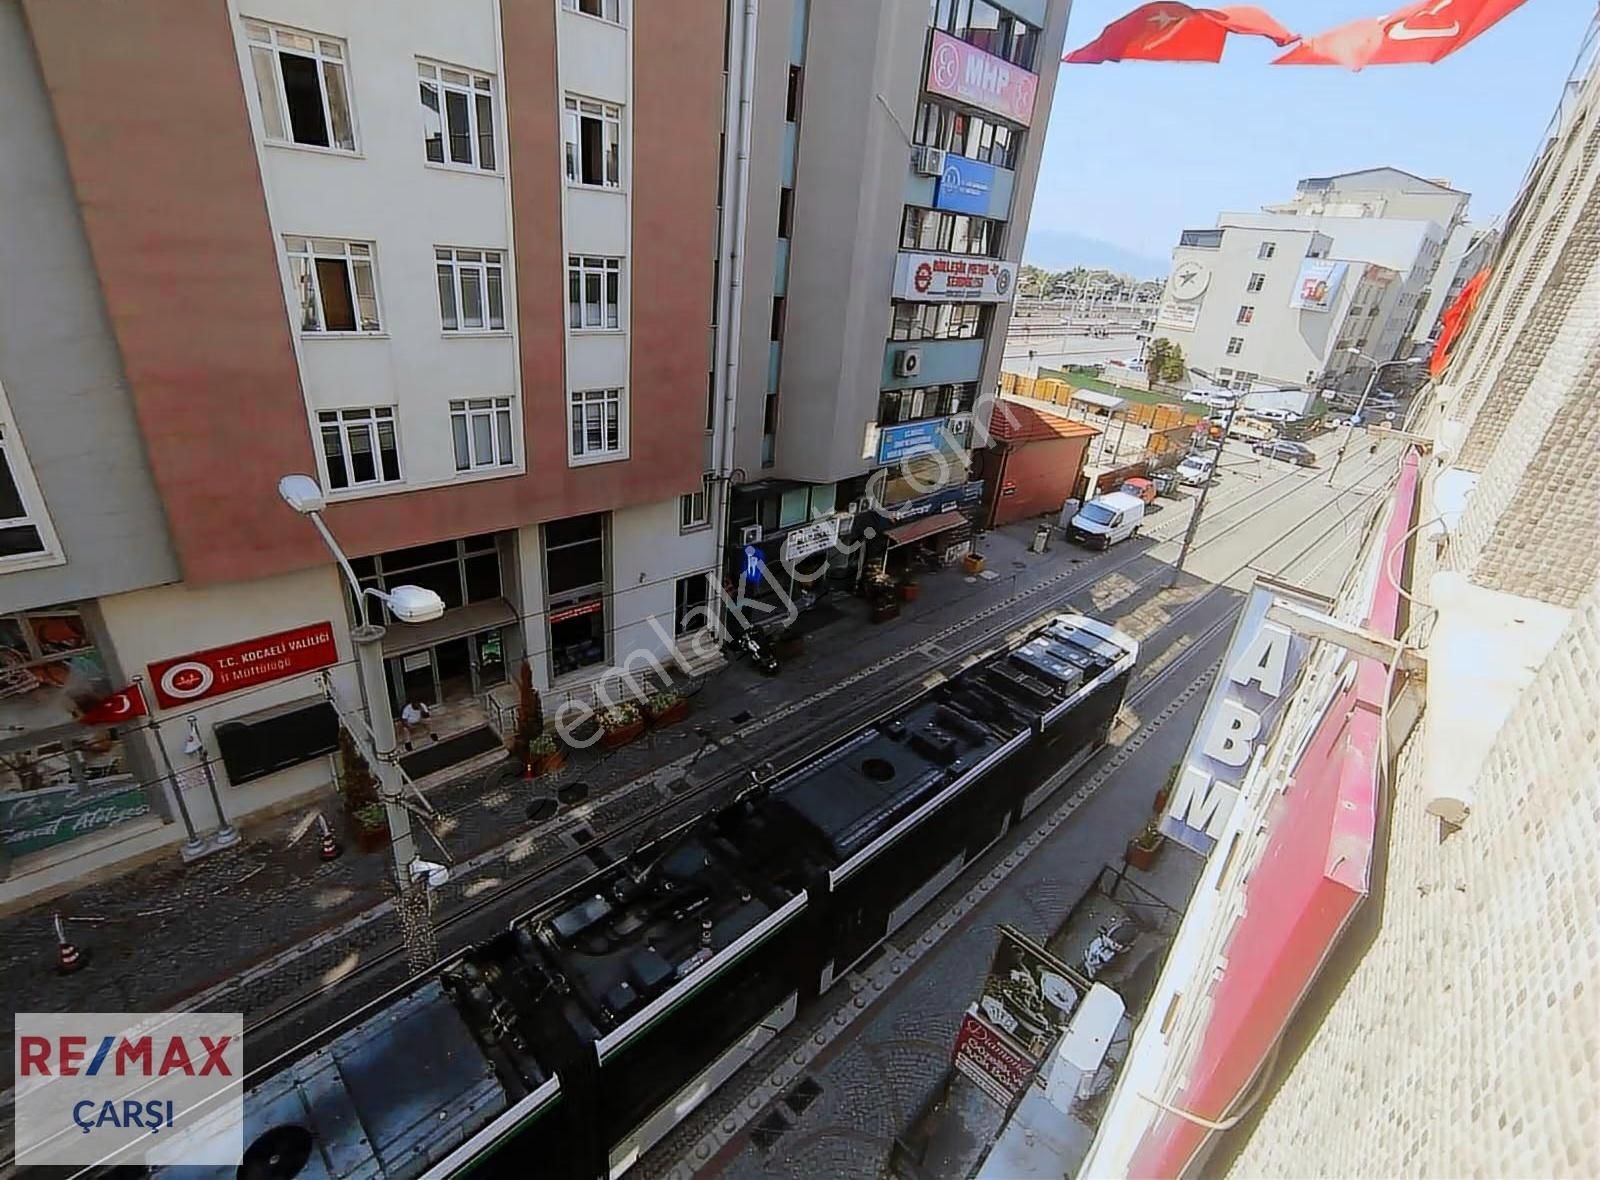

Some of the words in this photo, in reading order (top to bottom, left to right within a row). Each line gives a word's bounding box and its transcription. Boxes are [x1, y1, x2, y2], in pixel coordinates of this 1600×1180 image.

[965, 53, 1010, 95] MHP
[217, 656, 239, 669] T.C.
[241, 643, 286, 663] KOCAELİ
[1169, 618, 1291, 841] ABM
